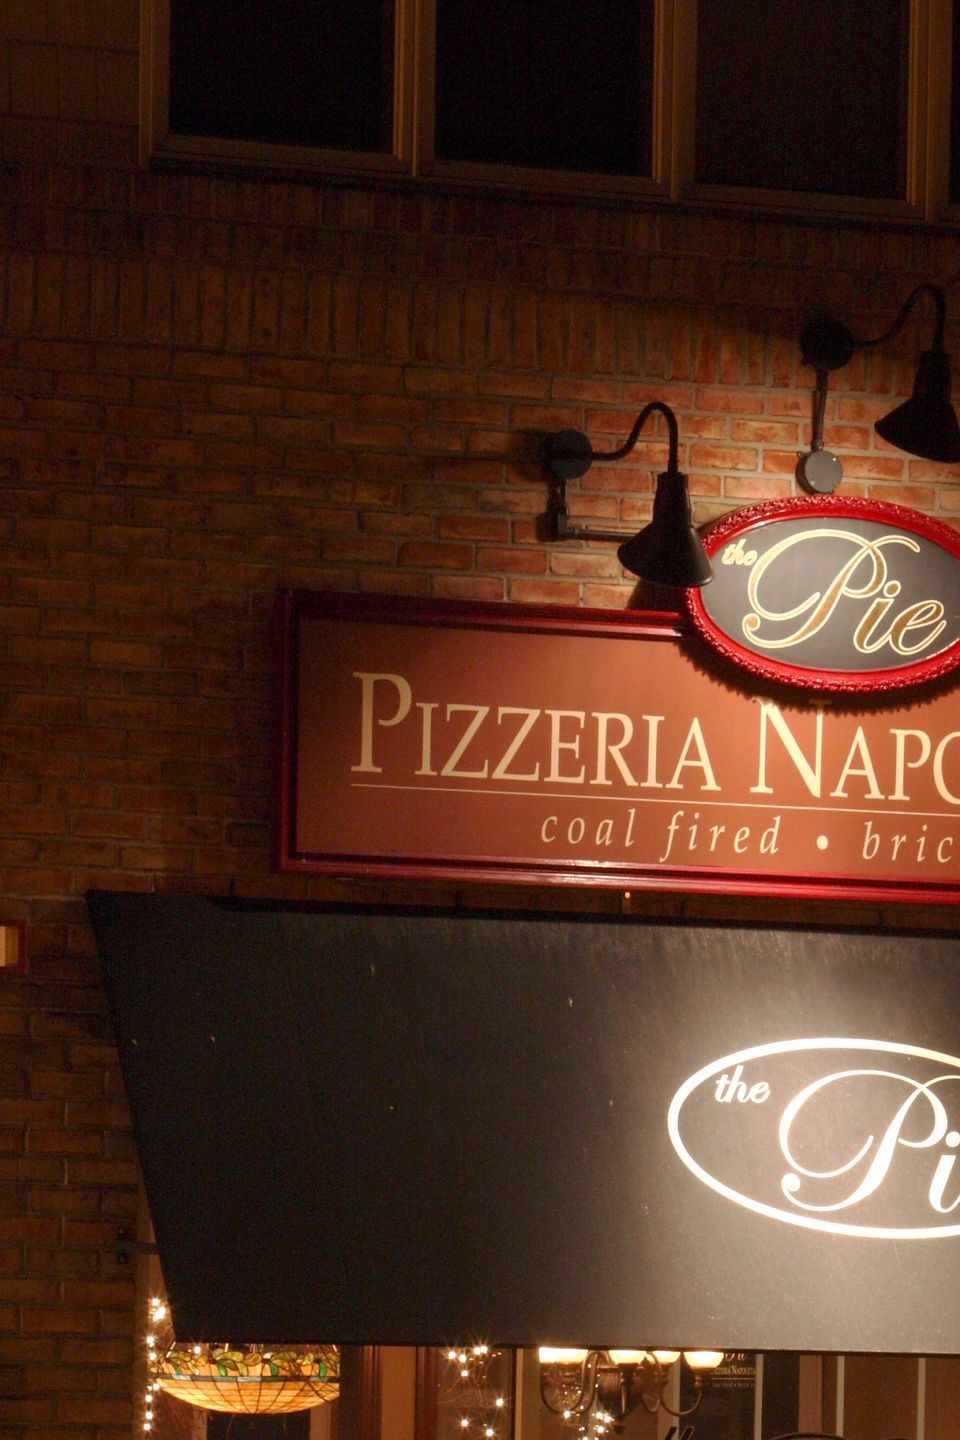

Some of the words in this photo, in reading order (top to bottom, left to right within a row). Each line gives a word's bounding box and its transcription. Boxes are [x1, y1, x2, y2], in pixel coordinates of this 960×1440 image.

[721, 538, 758, 566] the
[742, 528, 947, 656] Pie
[350, 670, 722, 791] PIZZERIA
[541, 808, 635, 847] coal
[659, 811, 781, 862] fired
[714, 1065, 771, 1104] the
